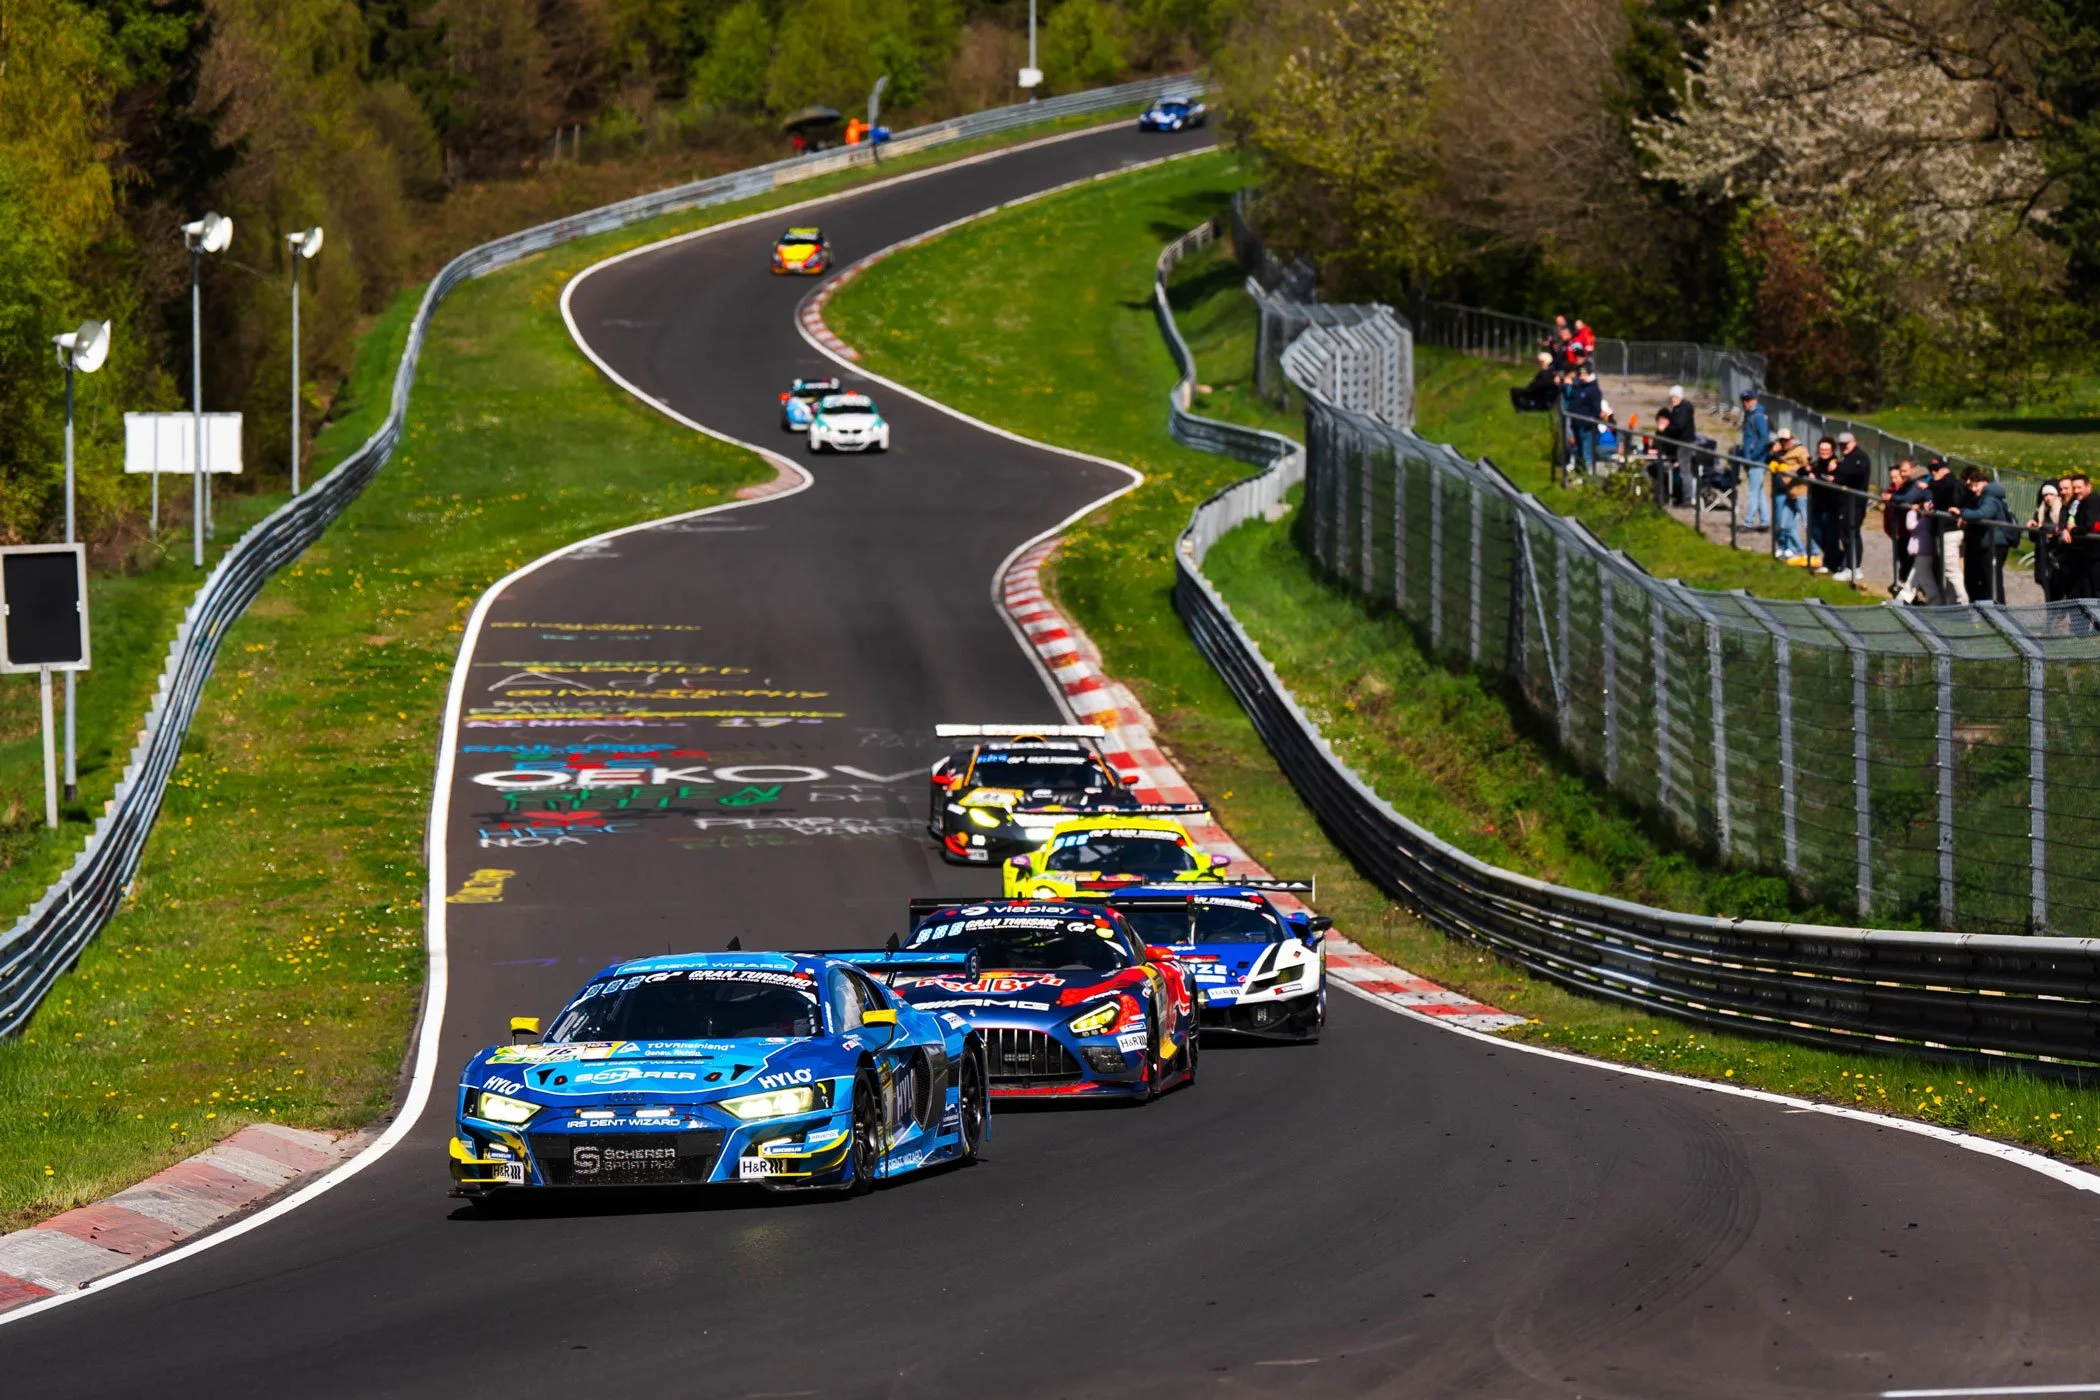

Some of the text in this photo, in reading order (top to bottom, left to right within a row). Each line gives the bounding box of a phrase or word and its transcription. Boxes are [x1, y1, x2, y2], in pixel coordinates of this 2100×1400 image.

[993, 905, 1074, 914] viaplay
[965, 918, 1002, 928] GRAN
[688, 970, 812, 986] GRAN TURISMO
[761, 979, 806, 990] SIMULATOR
[915, 977, 1067, 993] Red Bull
[952, 998, 1050, 1012] AMG
[1120, 1036, 1140, 1049] H&R
[574, 1070, 697, 1082] SCHERER
[567, 1118, 680, 1128] IRS DENT WIZARD
[604, 1148, 676, 1159] SCHERER
[604, 1160, 647, 1171] SPORT
[743, 1160, 768, 1173] H&R
